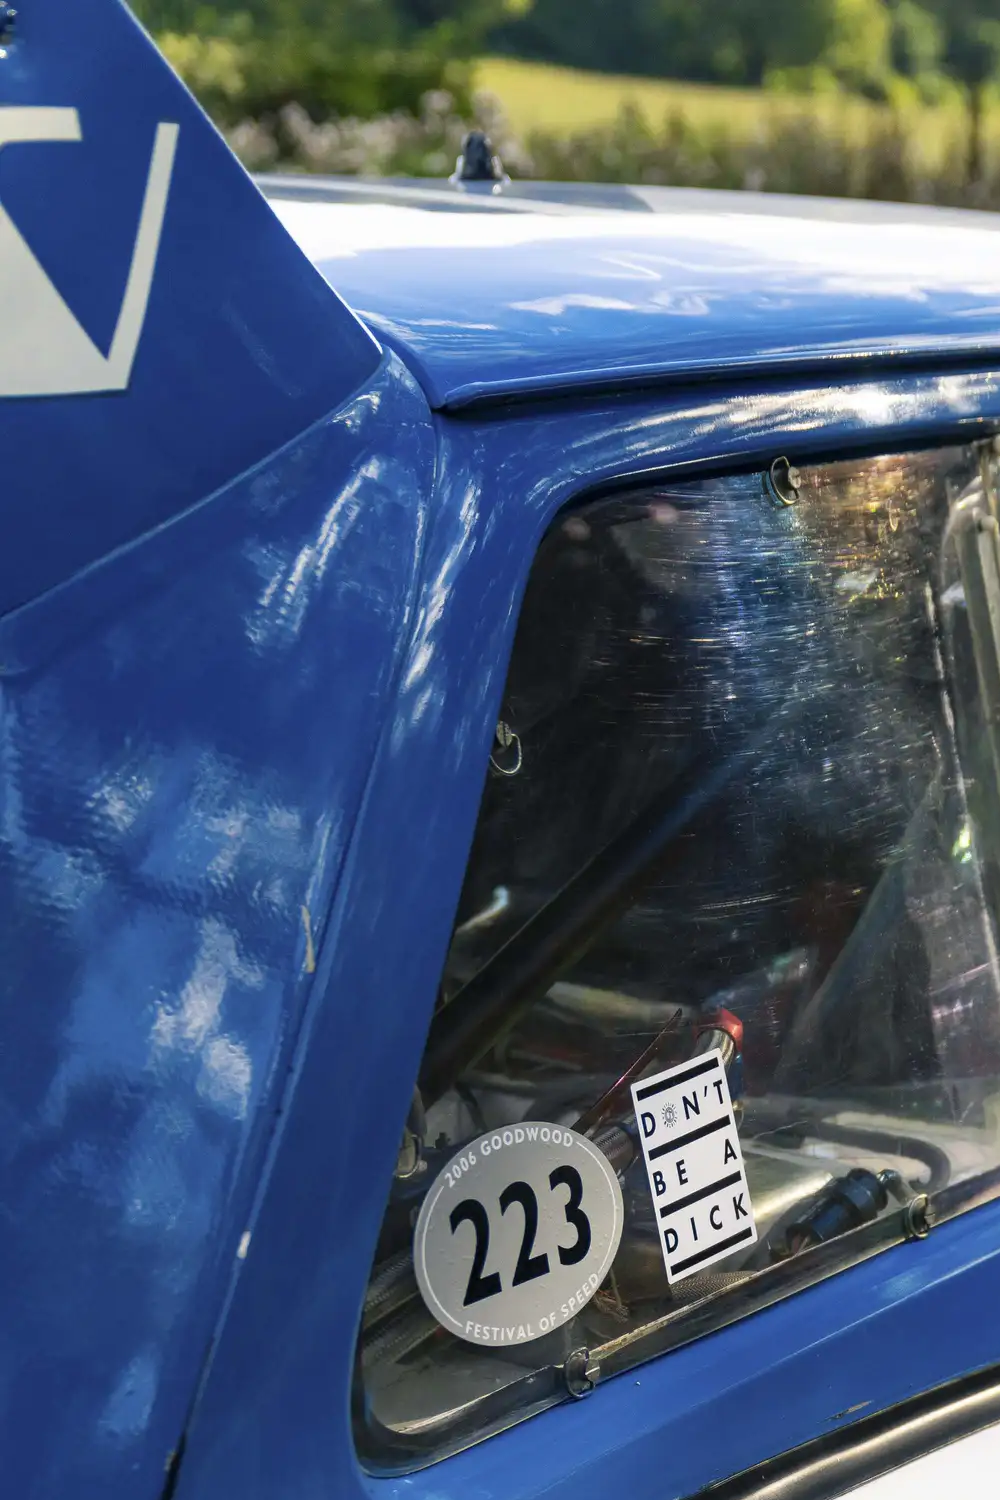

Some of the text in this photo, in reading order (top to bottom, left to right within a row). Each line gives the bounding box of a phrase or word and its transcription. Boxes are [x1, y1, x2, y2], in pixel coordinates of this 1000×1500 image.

[444, 1127, 573, 1189] 2006 GOODWOOD
[653, 1138, 737, 1197] BE A
[449, 1165, 592, 1307] 223
[664, 1193, 749, 1255] DICK
[465, 1272, 600, 1342] FESTIVAL OF SPEED
